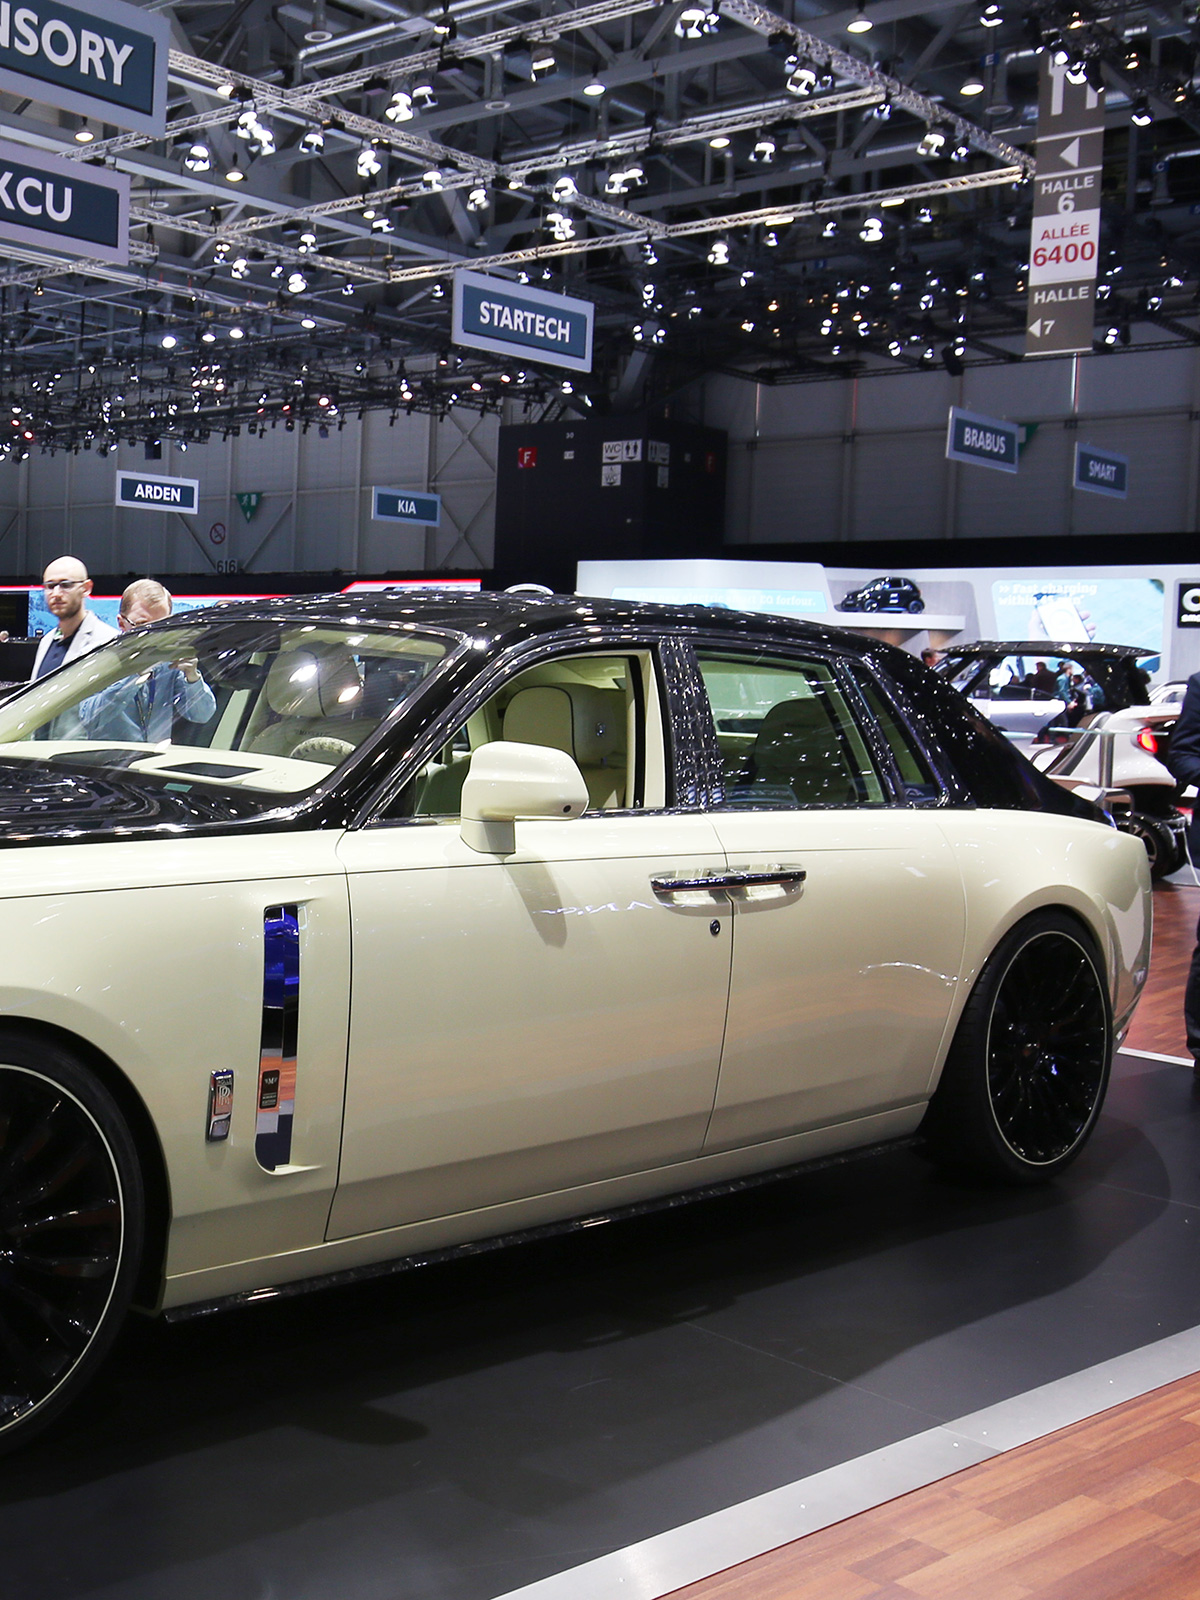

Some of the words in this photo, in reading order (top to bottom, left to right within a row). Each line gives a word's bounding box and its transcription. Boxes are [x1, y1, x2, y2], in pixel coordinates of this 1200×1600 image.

[1041, 175, 1094, 195] HALLE
[1057, 192, 1076, 214] 6
[1040, 223, 1090, 241] ALLÉE
[1033, 241, 1095, 267] 6400
[1033, 286, 1089, 304] HALLE
[479, 301, 570, 343] STARTECH
[1043, 319, 1056, 335] 7
[605, 443, 620, 453] WC
[963, 427, 1006, 454] BRABUS
[1089, 460, 1116, 482] SMART
[135, 483, 181, 502] ARDEN
[397, 499, 417, 515] KIA
[216, 560, 236, 574] 616
